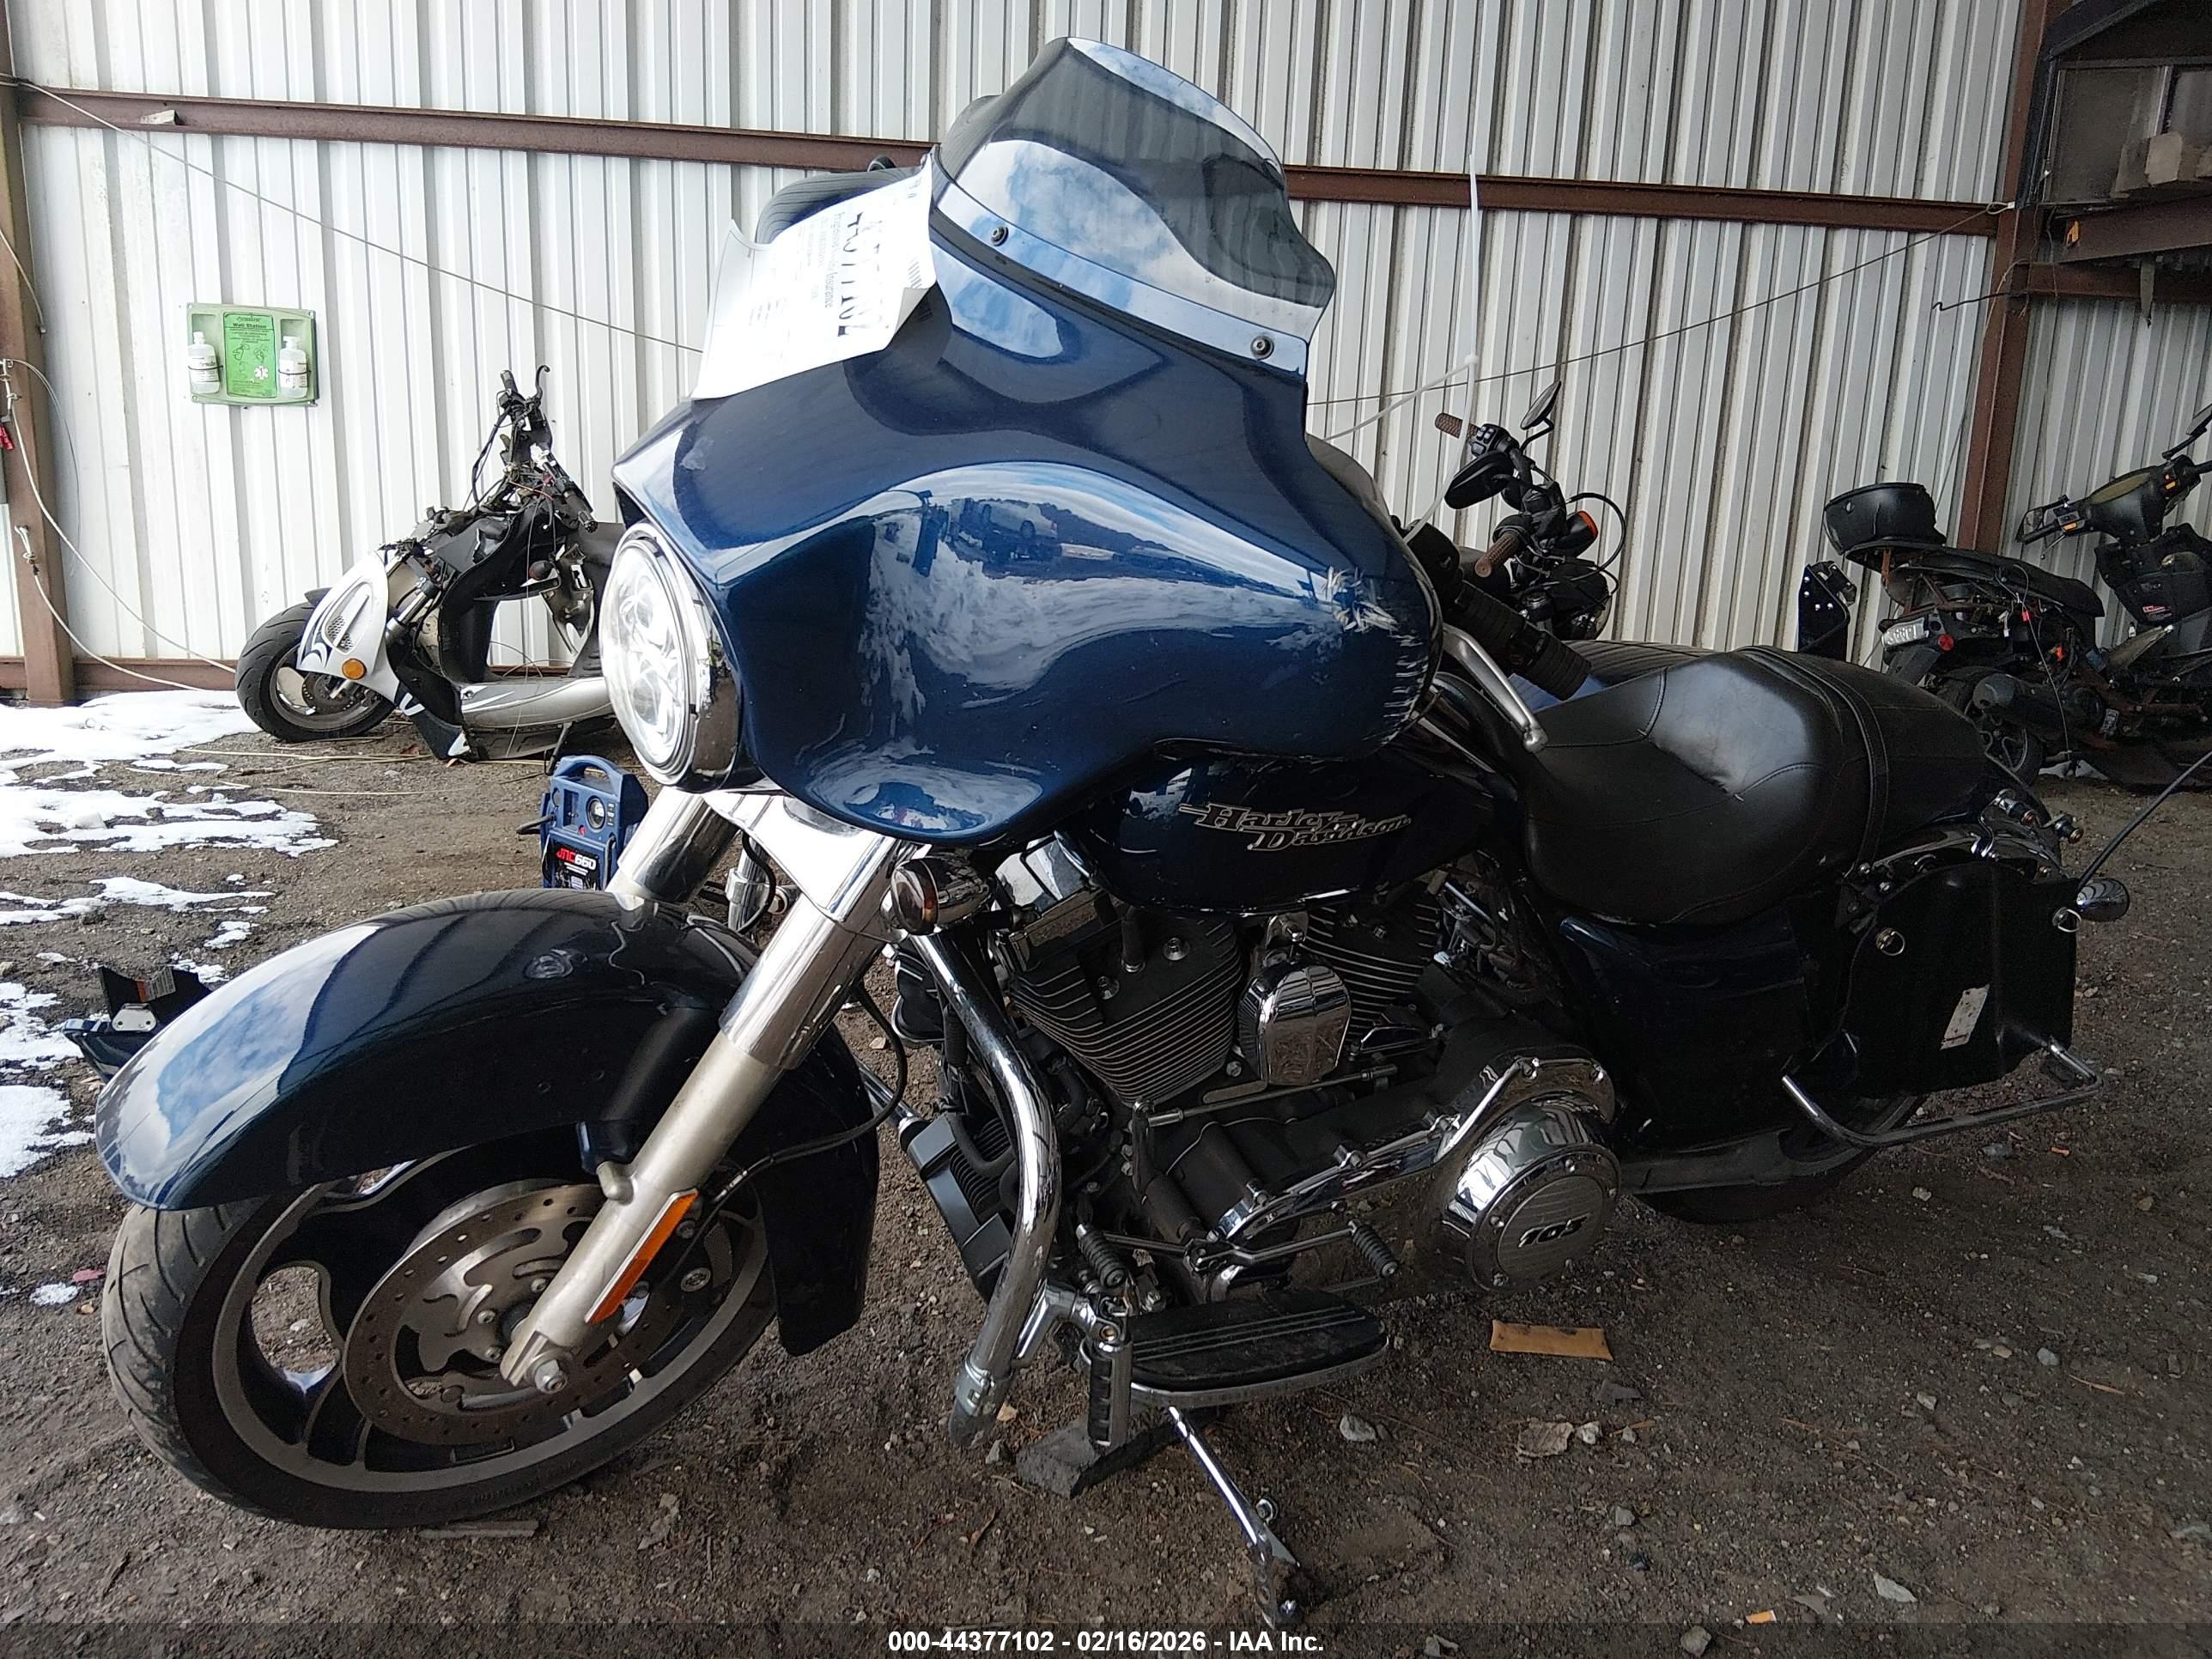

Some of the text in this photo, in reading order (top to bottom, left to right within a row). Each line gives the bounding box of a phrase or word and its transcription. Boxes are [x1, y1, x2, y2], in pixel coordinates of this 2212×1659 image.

[824, 271, 838, 308] Insurance
[1179, 803, 1359, 831] Harley
[1246, 814, 1412, 851] Davidson
[556, 848, 597, 871] JNC660
